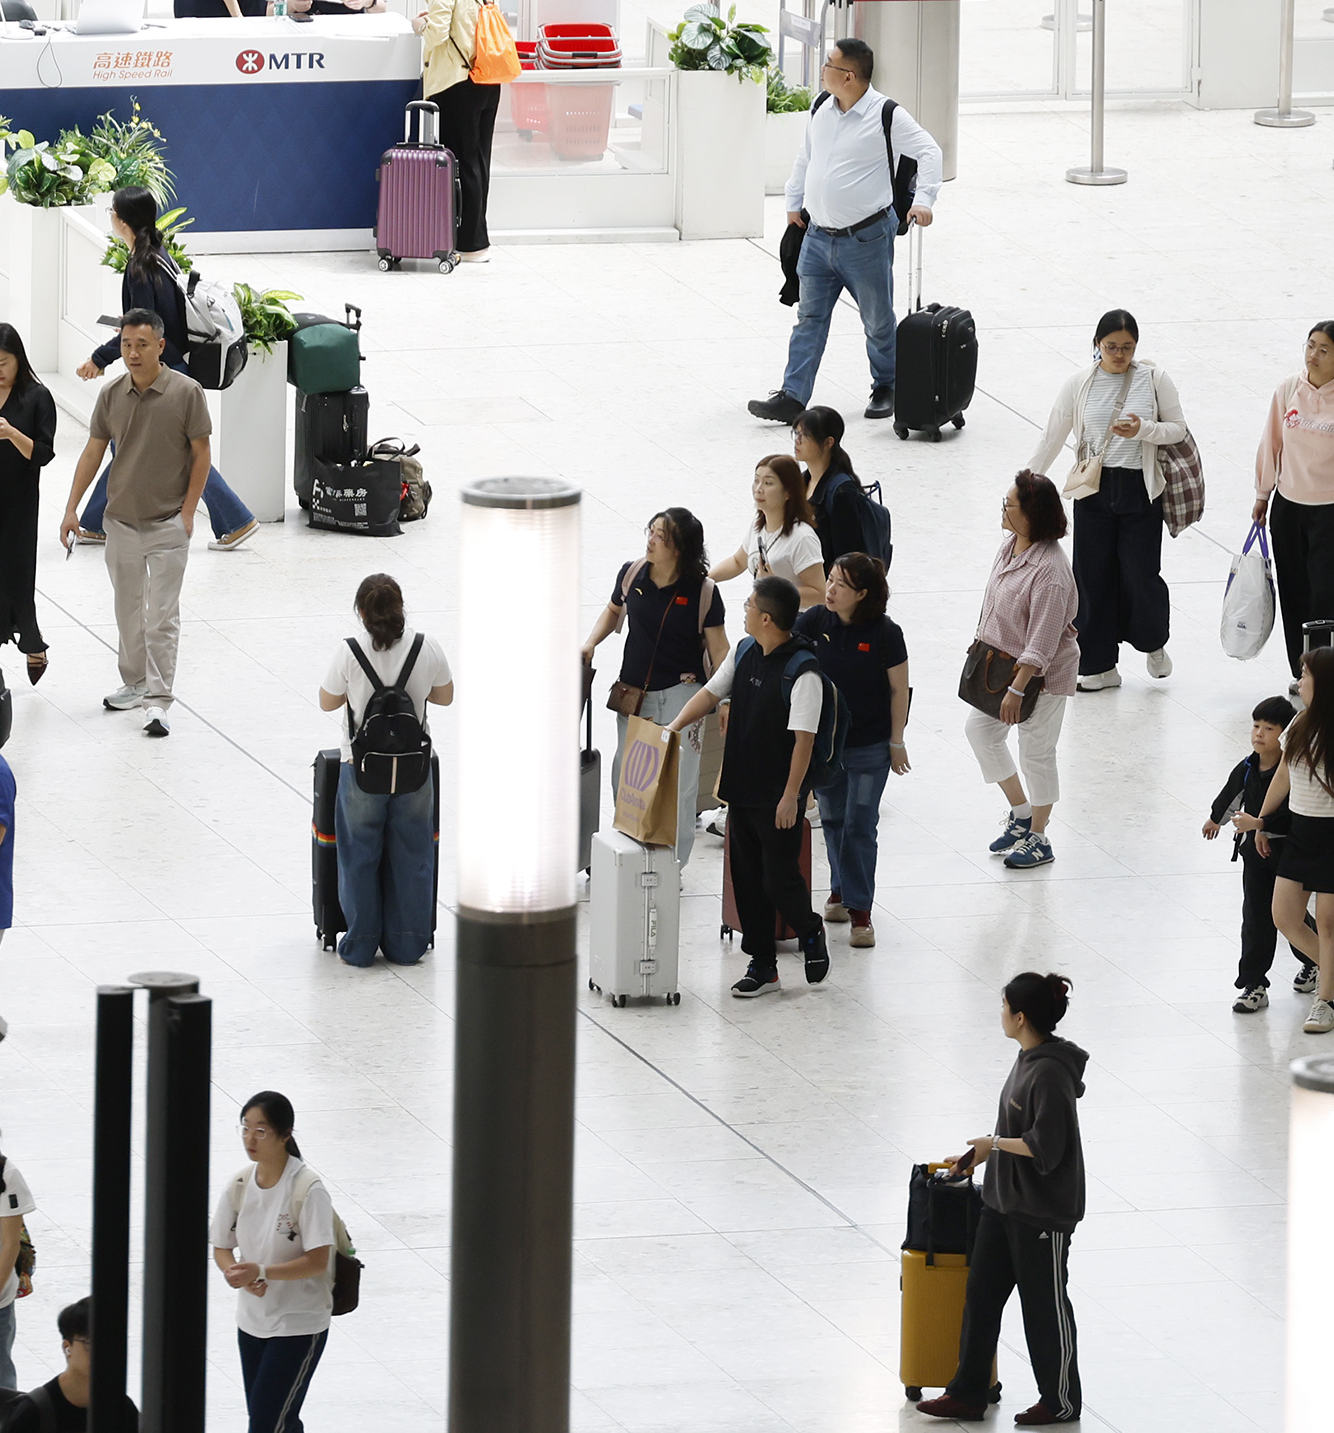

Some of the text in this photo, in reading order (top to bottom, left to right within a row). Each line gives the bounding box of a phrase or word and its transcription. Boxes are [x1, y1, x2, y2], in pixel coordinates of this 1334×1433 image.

[93, 51, 173, 69] 高速鐵路
[269, 52, 325, 70] MTR
[92, 68, 173, 82] High Speed Rail
